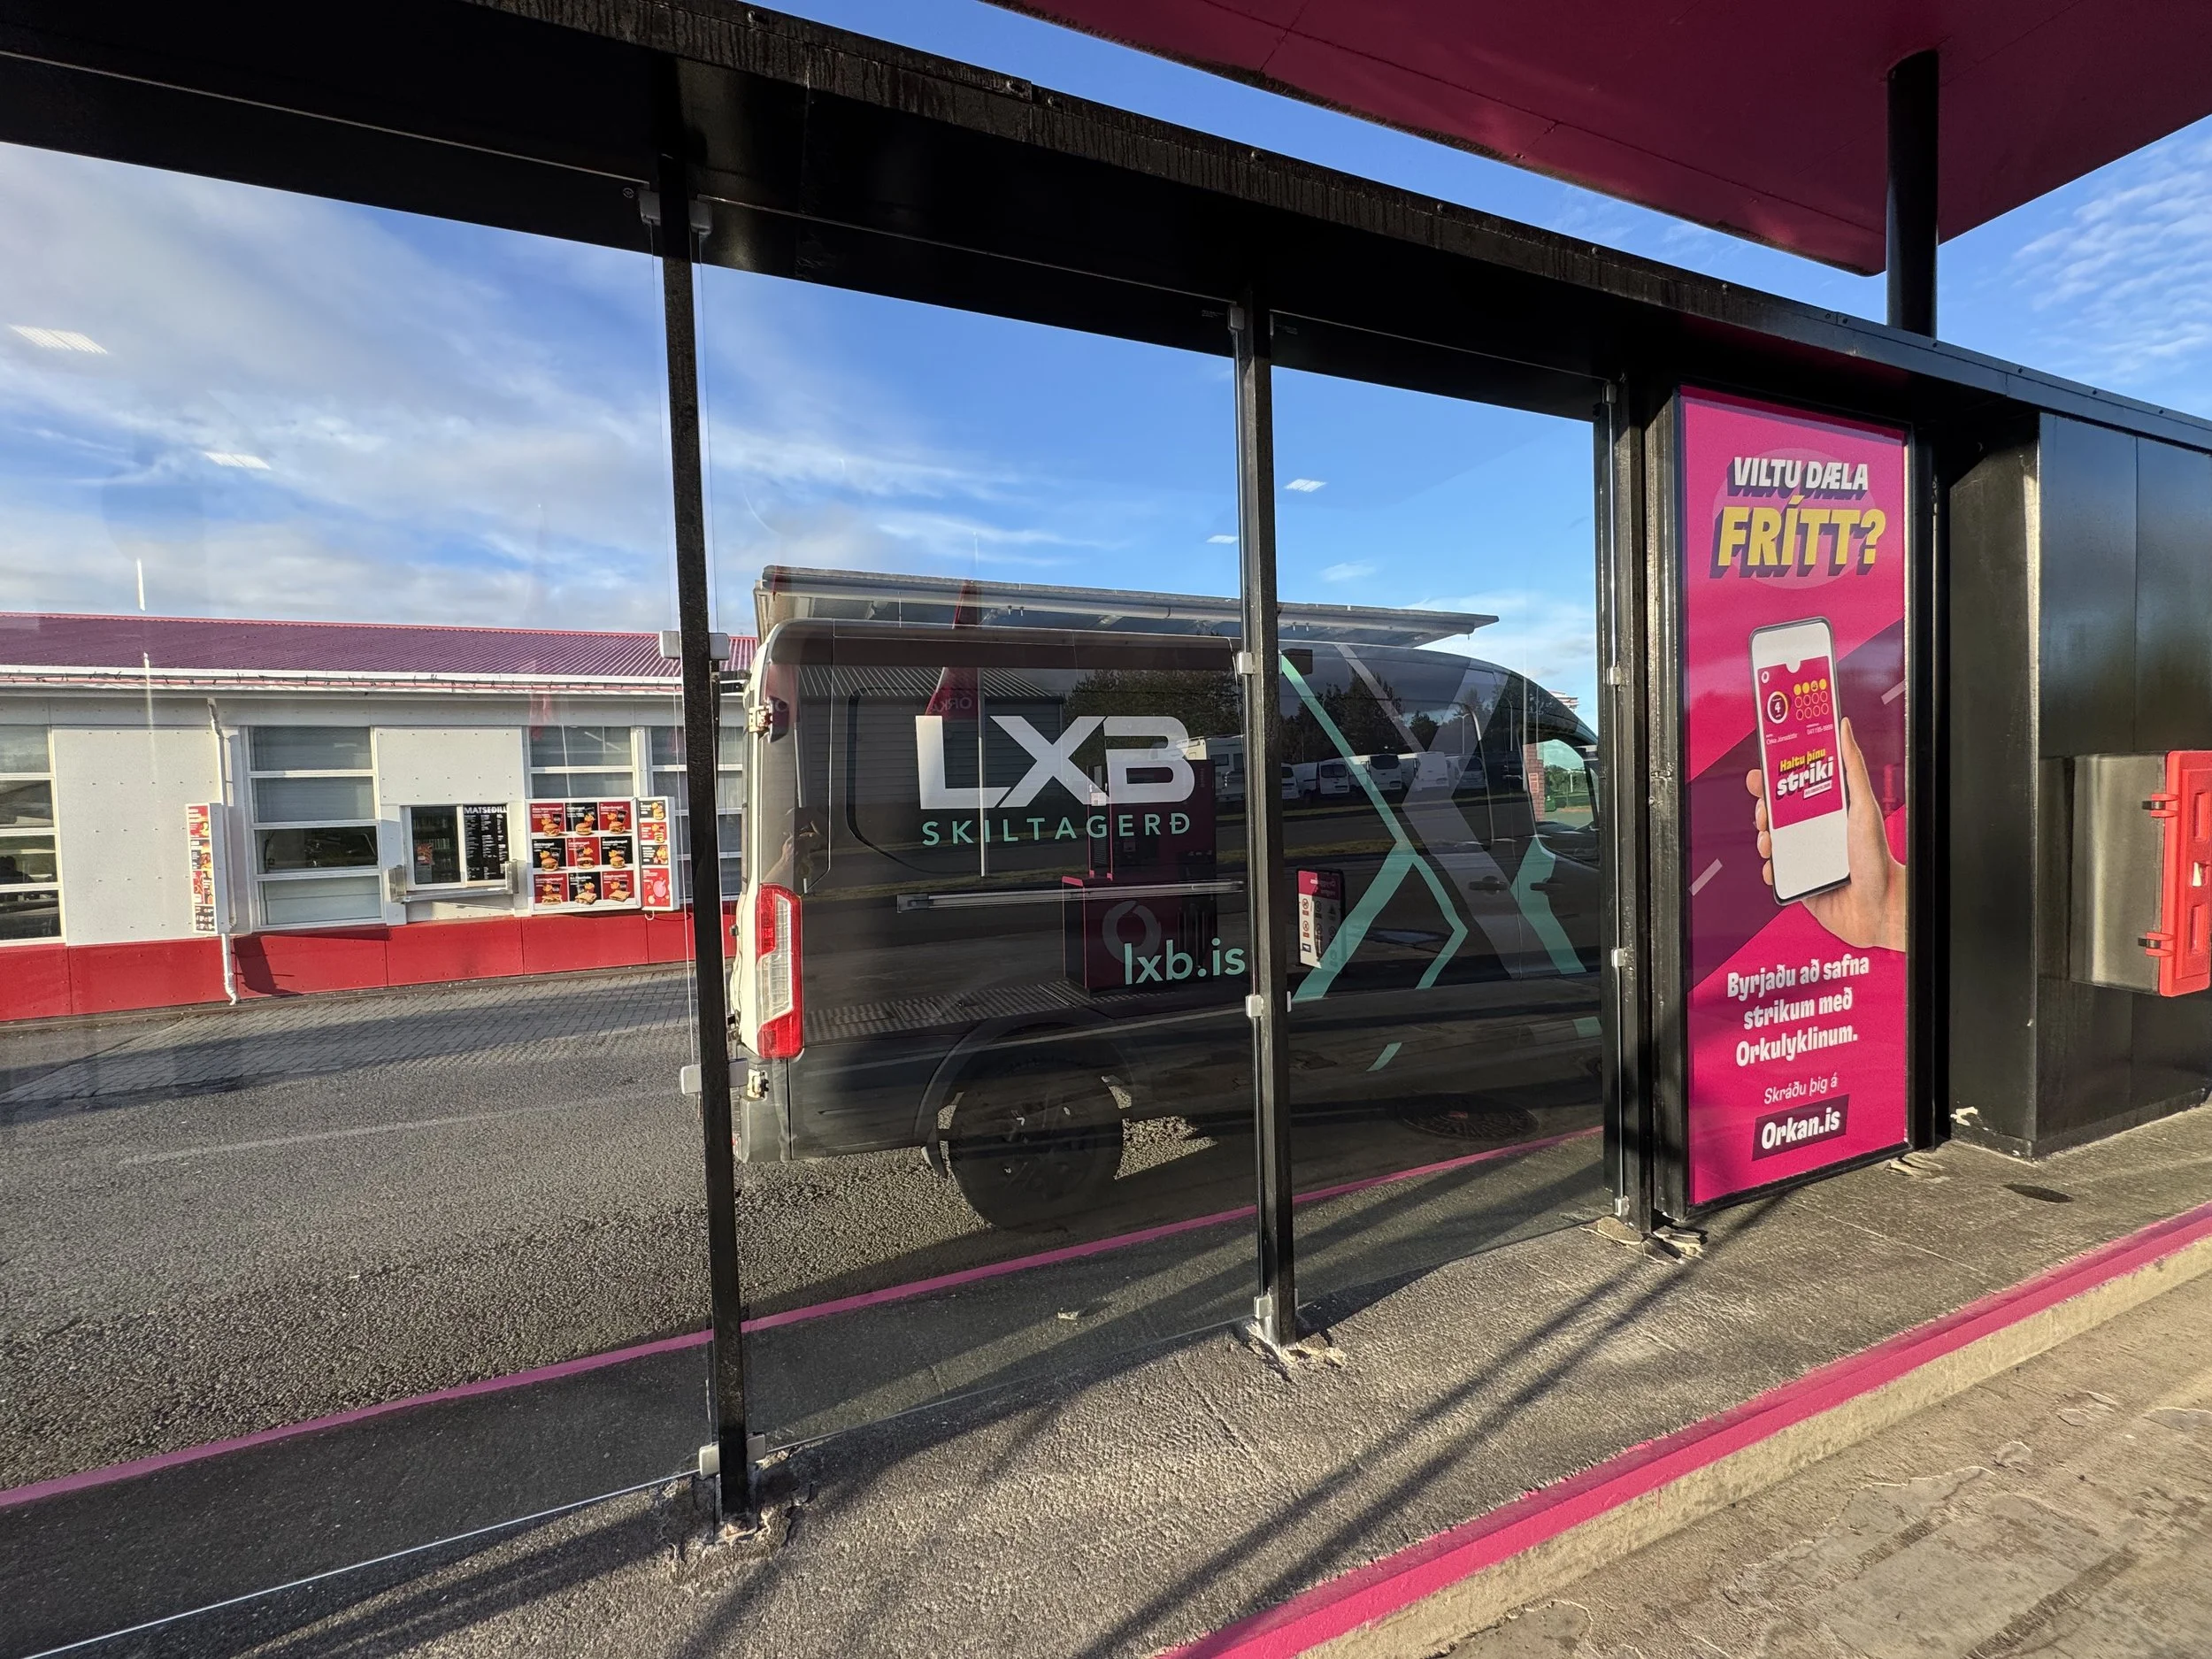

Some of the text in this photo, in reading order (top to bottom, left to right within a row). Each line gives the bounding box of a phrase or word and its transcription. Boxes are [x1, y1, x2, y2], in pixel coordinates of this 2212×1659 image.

[1732, 457, 1868, 490] VILTU DÆLA
[1717, 495, 1886, 566] FRÍTT?
[915, 716, 1195, 810] LXB
[1777, 756, 1833, 796] striki
[1779, 749, 1826, 772] Haltu þinu
[921, 812, 1190, 847] SKILTAGERÐ
[1123, 938, 1246, 986] lxb.is
[1727, 953, 1870, 1002] Byrjaðu að safna
[1743, 987, 1853, 1030] strikum með
[1736, 1025, 1858, 1067] Orkulyklinum.
[1763, 1071, 1838, 1104] Skráðu þig á
[1761, 1107, 1840, 1150] Orkan.is
